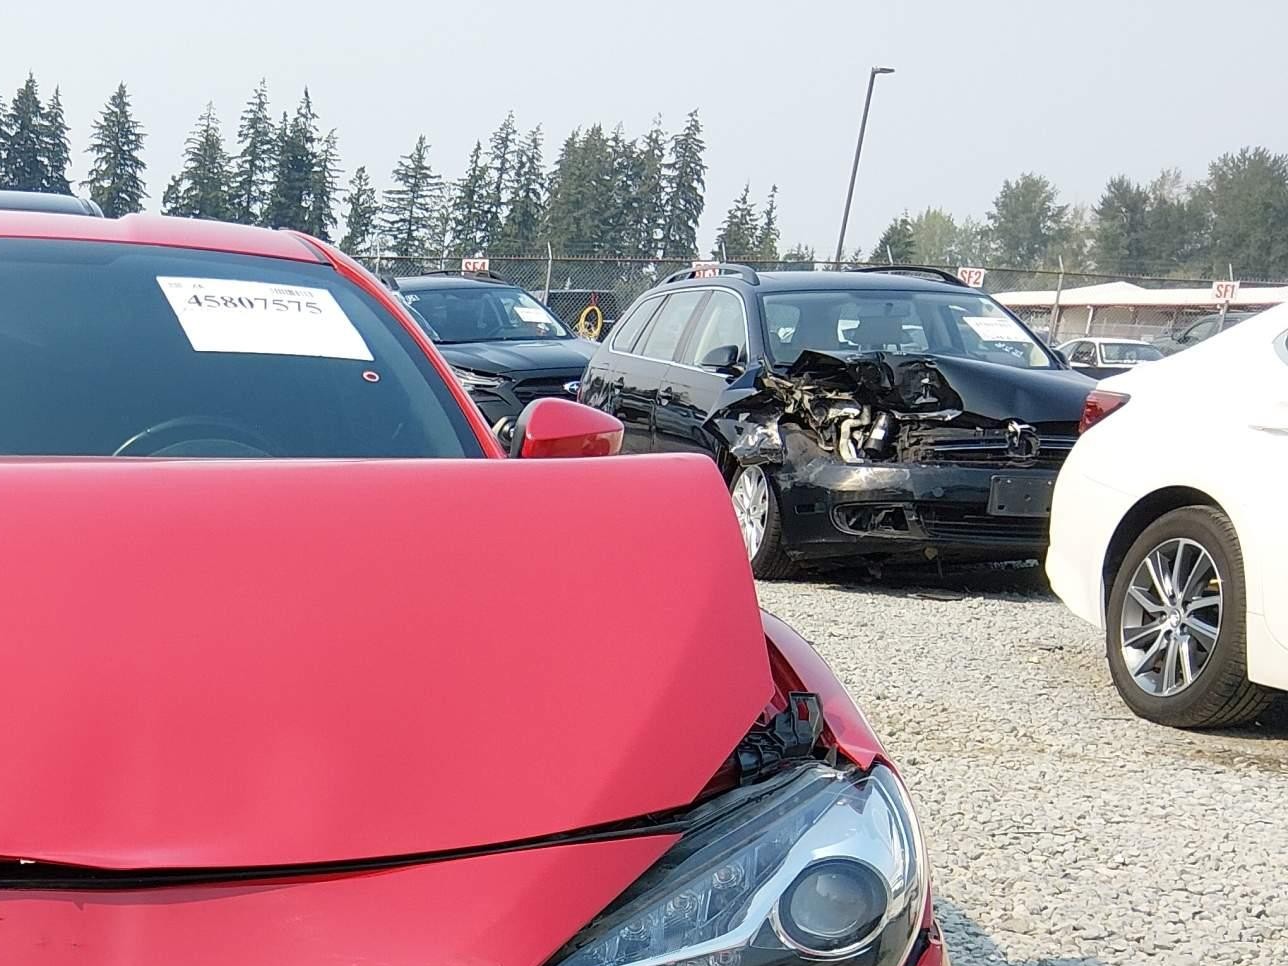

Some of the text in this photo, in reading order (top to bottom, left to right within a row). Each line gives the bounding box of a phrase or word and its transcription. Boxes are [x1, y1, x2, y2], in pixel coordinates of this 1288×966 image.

[960, 269, 982, 285] SF2
[1215, 283, 1235, 299] SF1
[187, 292, 323, 315] 45807575
